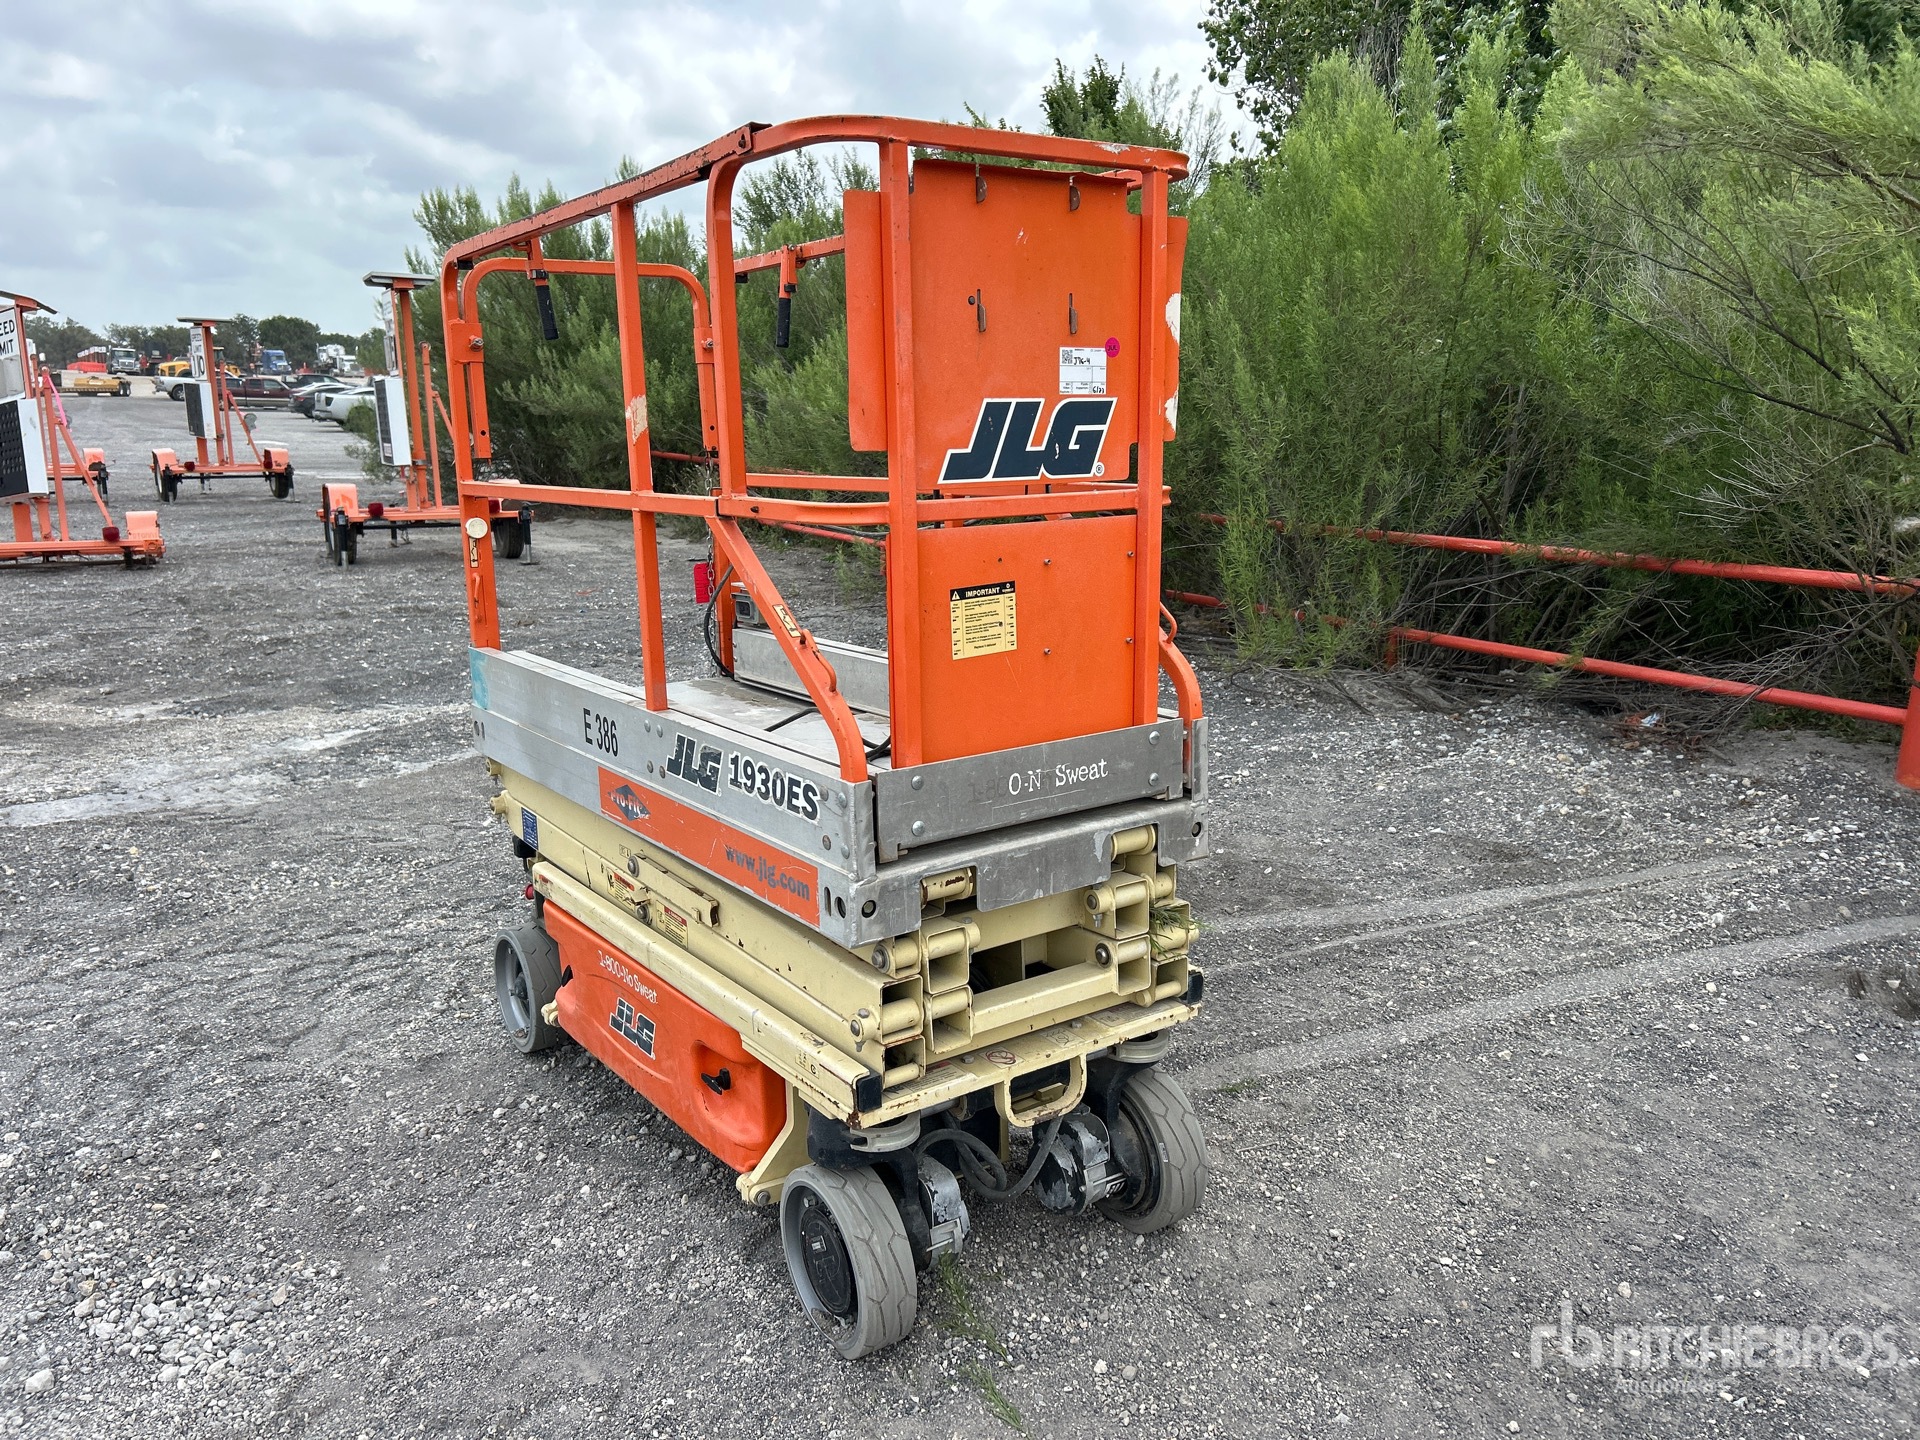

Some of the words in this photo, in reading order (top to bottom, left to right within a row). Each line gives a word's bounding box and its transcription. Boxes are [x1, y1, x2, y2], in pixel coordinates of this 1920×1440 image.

[937, 397, 1118, 484] JLG
[965, 586, 1000, 599] IMPORTANT
[583, 707, 594, 746] E
[595, 713, 619, 757] 386
[666, 732, 724, 797] JLG
[728, 751, 821, 825] 1930ES
[1055, 758, 1109, 787] Sweat
[725, 844, 811, 901] www.jlg.com
[598, 949, 634, 987] 1-800-No
[634, 974, 658, 1004] Sweat
[609, 996, 656, 1060] JLG
